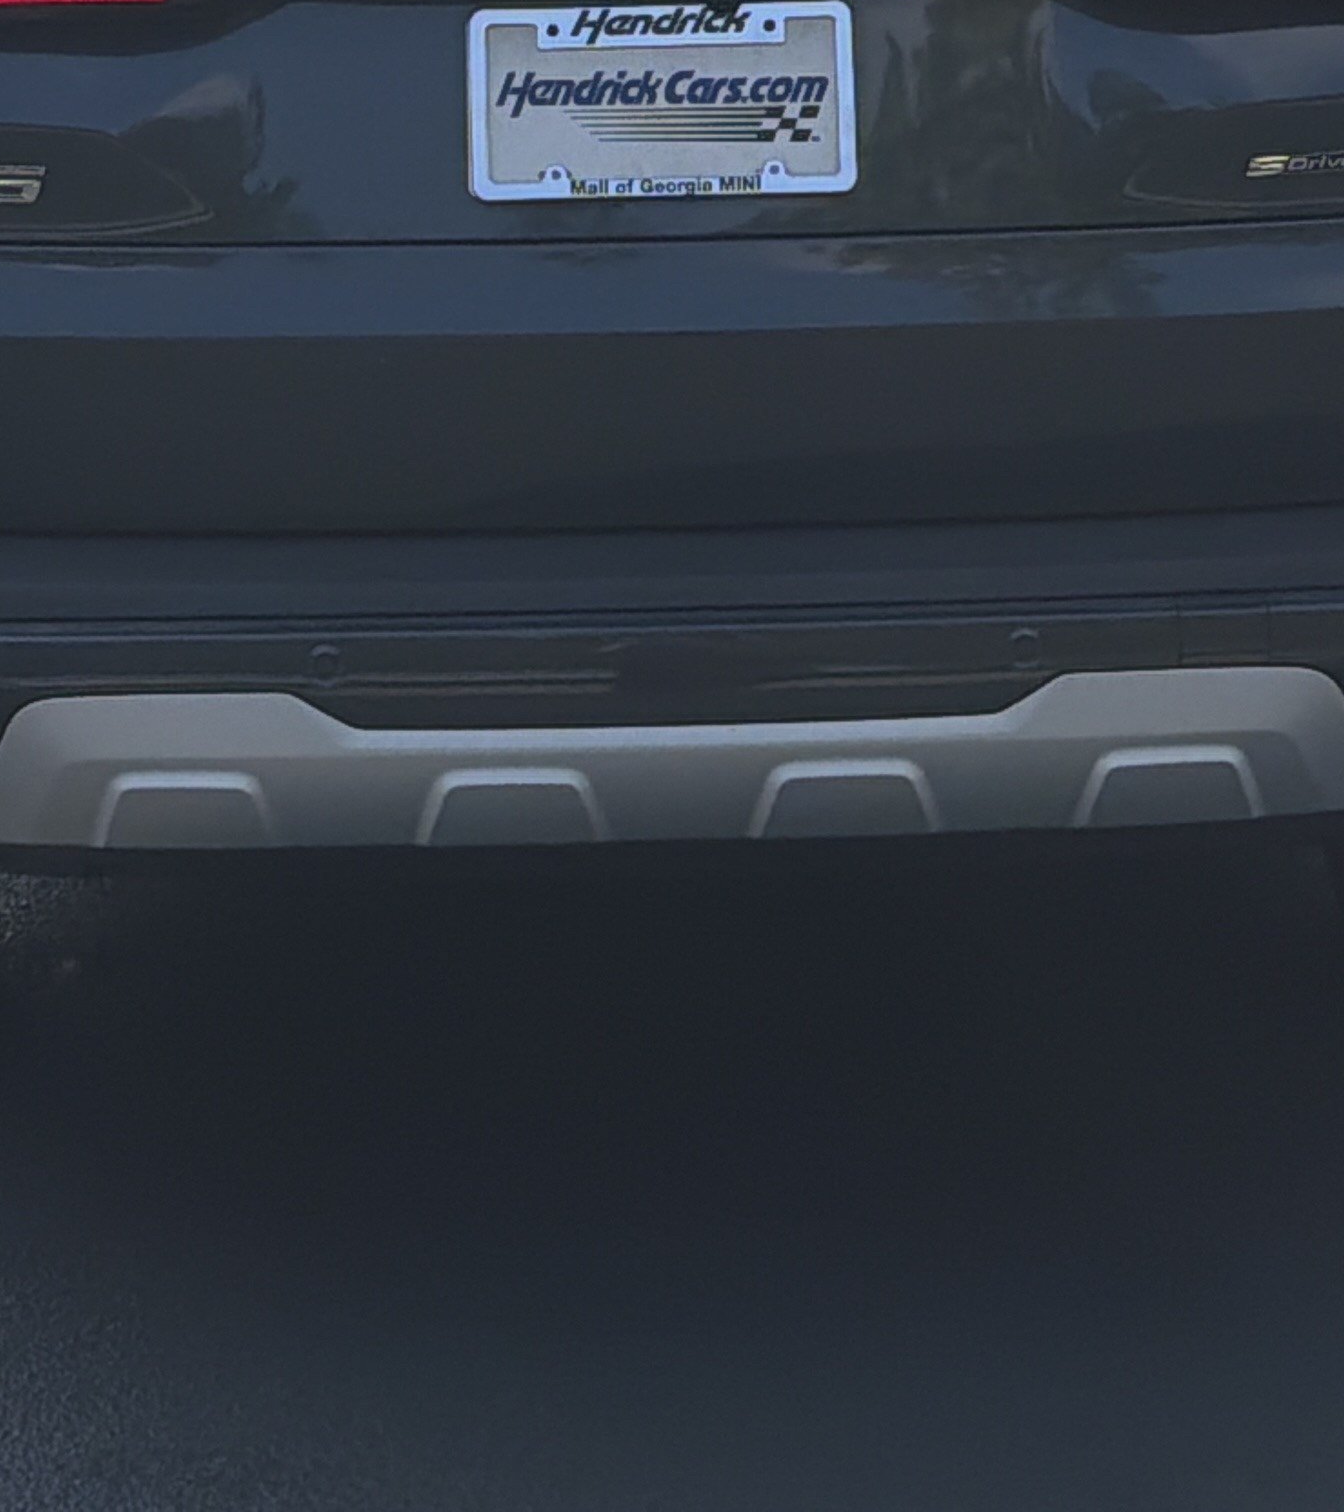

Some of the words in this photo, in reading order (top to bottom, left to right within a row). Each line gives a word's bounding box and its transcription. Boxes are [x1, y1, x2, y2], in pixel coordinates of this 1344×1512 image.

[570, 6, 753, 45] Hendrick
[570, 178, 609, 196] Mall
[615, 178, 634, 194] of
[640, 176, 713, 197] Georgia
[719, 174, 762, 192] MINI
